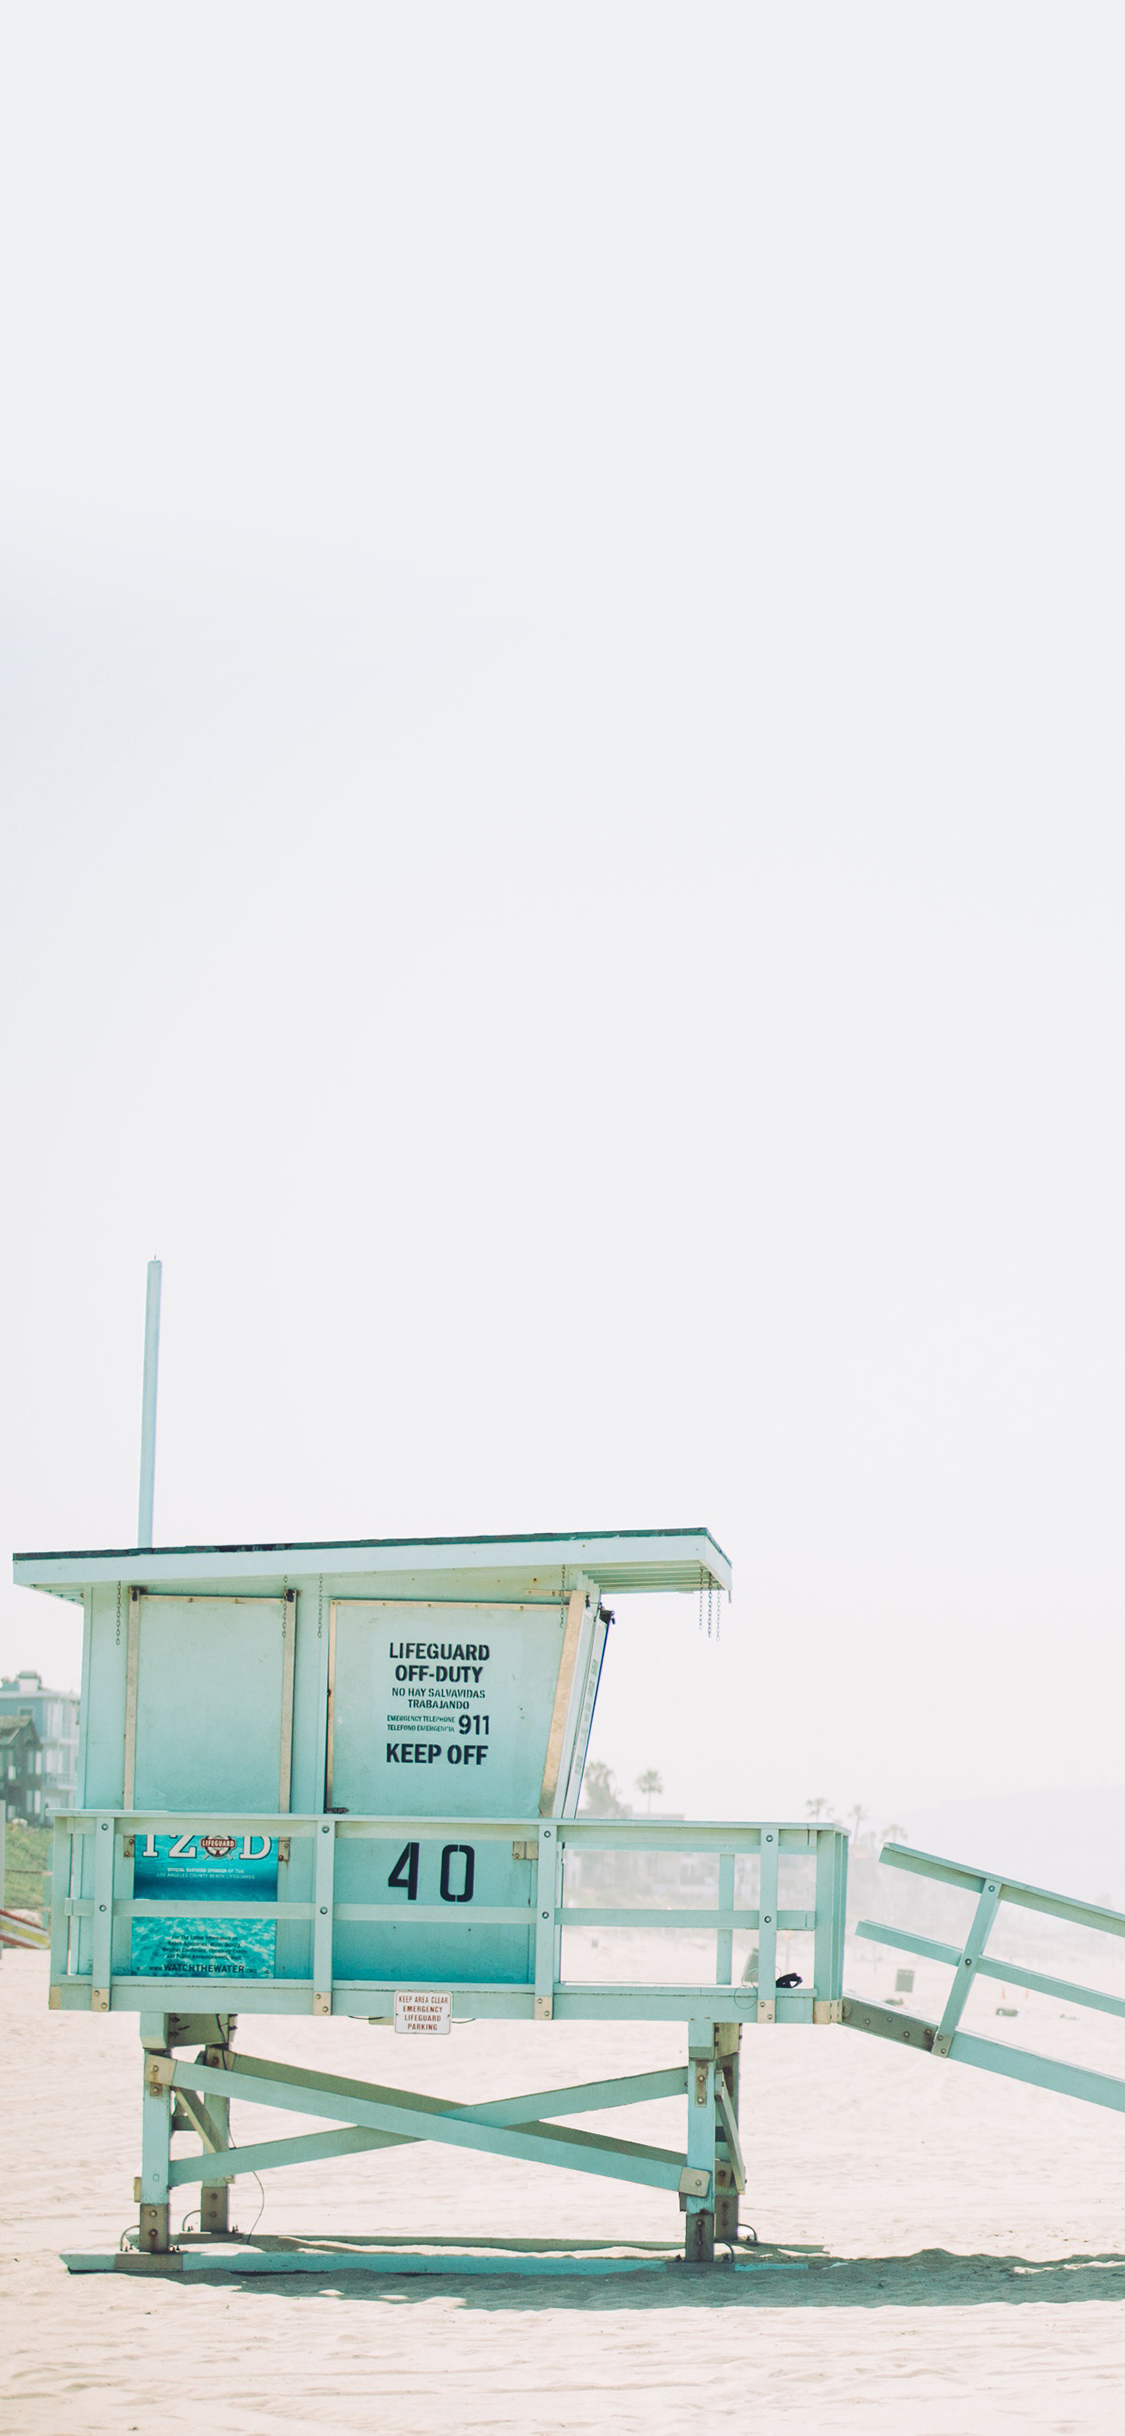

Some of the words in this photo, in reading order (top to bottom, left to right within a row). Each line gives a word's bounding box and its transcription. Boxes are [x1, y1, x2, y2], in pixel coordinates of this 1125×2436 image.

[389, 1642, 490, 1661] LIFEGUARD
[394, 1664, 484, 1683] OFF-DUTY
[392, 1687, 406, 1697] NO
[408, 1687, 427, 1697] HAY
[428, 1688, 486, 1699] SALVAVIDAS
[408, 1699, 470, 1710] TRABAJANDO
[423, 1715, 455, 1723] TELEPHONE
[458, 1714, 490, 1735] 911
[386, 1743, 442, 1764] KEEP
[447, 1744, 489, 1765] OFF
[202, 1839, 235, 1848] LIFEGUARD
[388, 1842, 475, 1903] 40
[399, 1995, 412, 2003] KEEP
[414, 1996, 429, 2004] AREA
[431, 1996, 448, 2004] CLEAR
[403, 2005, 443, 2013] EMERGENCY
[404, 2014, 442, 2022] LIFEGUARD
[407, 2023, 438, 2031] PARKING
